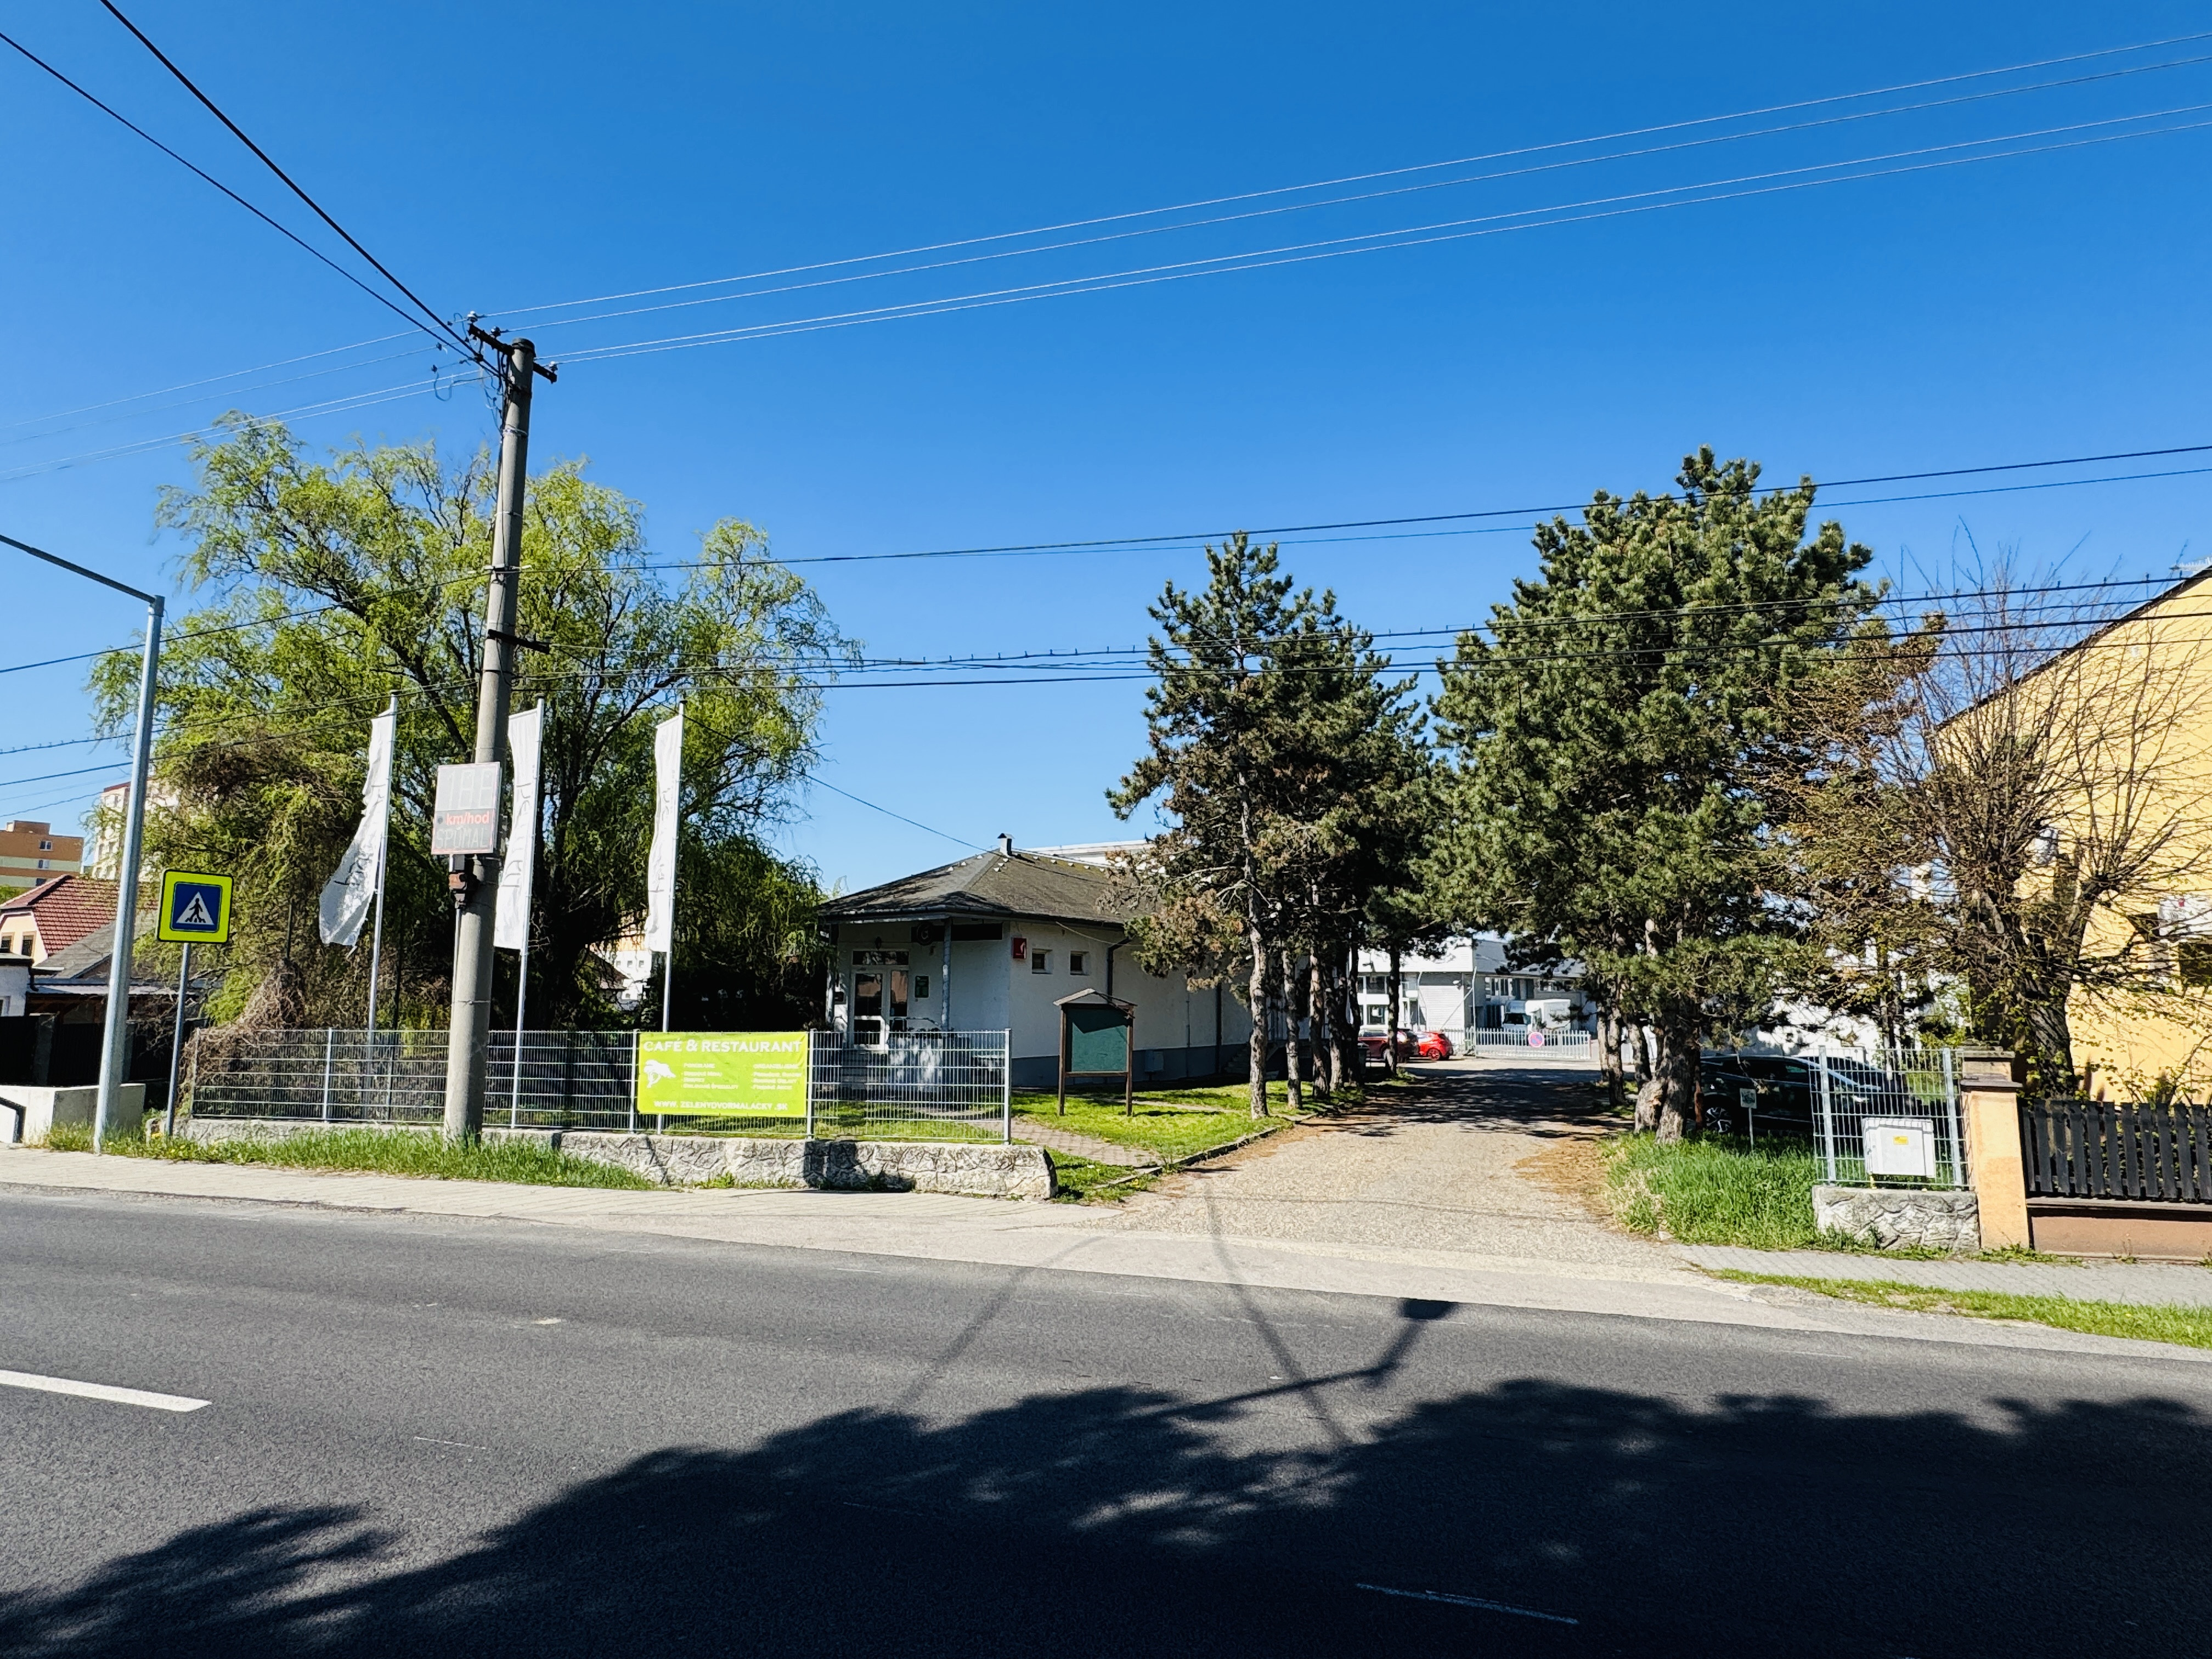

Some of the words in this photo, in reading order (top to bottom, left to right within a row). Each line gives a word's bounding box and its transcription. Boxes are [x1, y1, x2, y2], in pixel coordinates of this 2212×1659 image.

[446, 811, 489, 825] km/hod
[643, 1038, 682, 1052] CAFÉ
[686, 1039, 698, 1052] &
[702, 1040, 802, 1052] RESTAURANT
